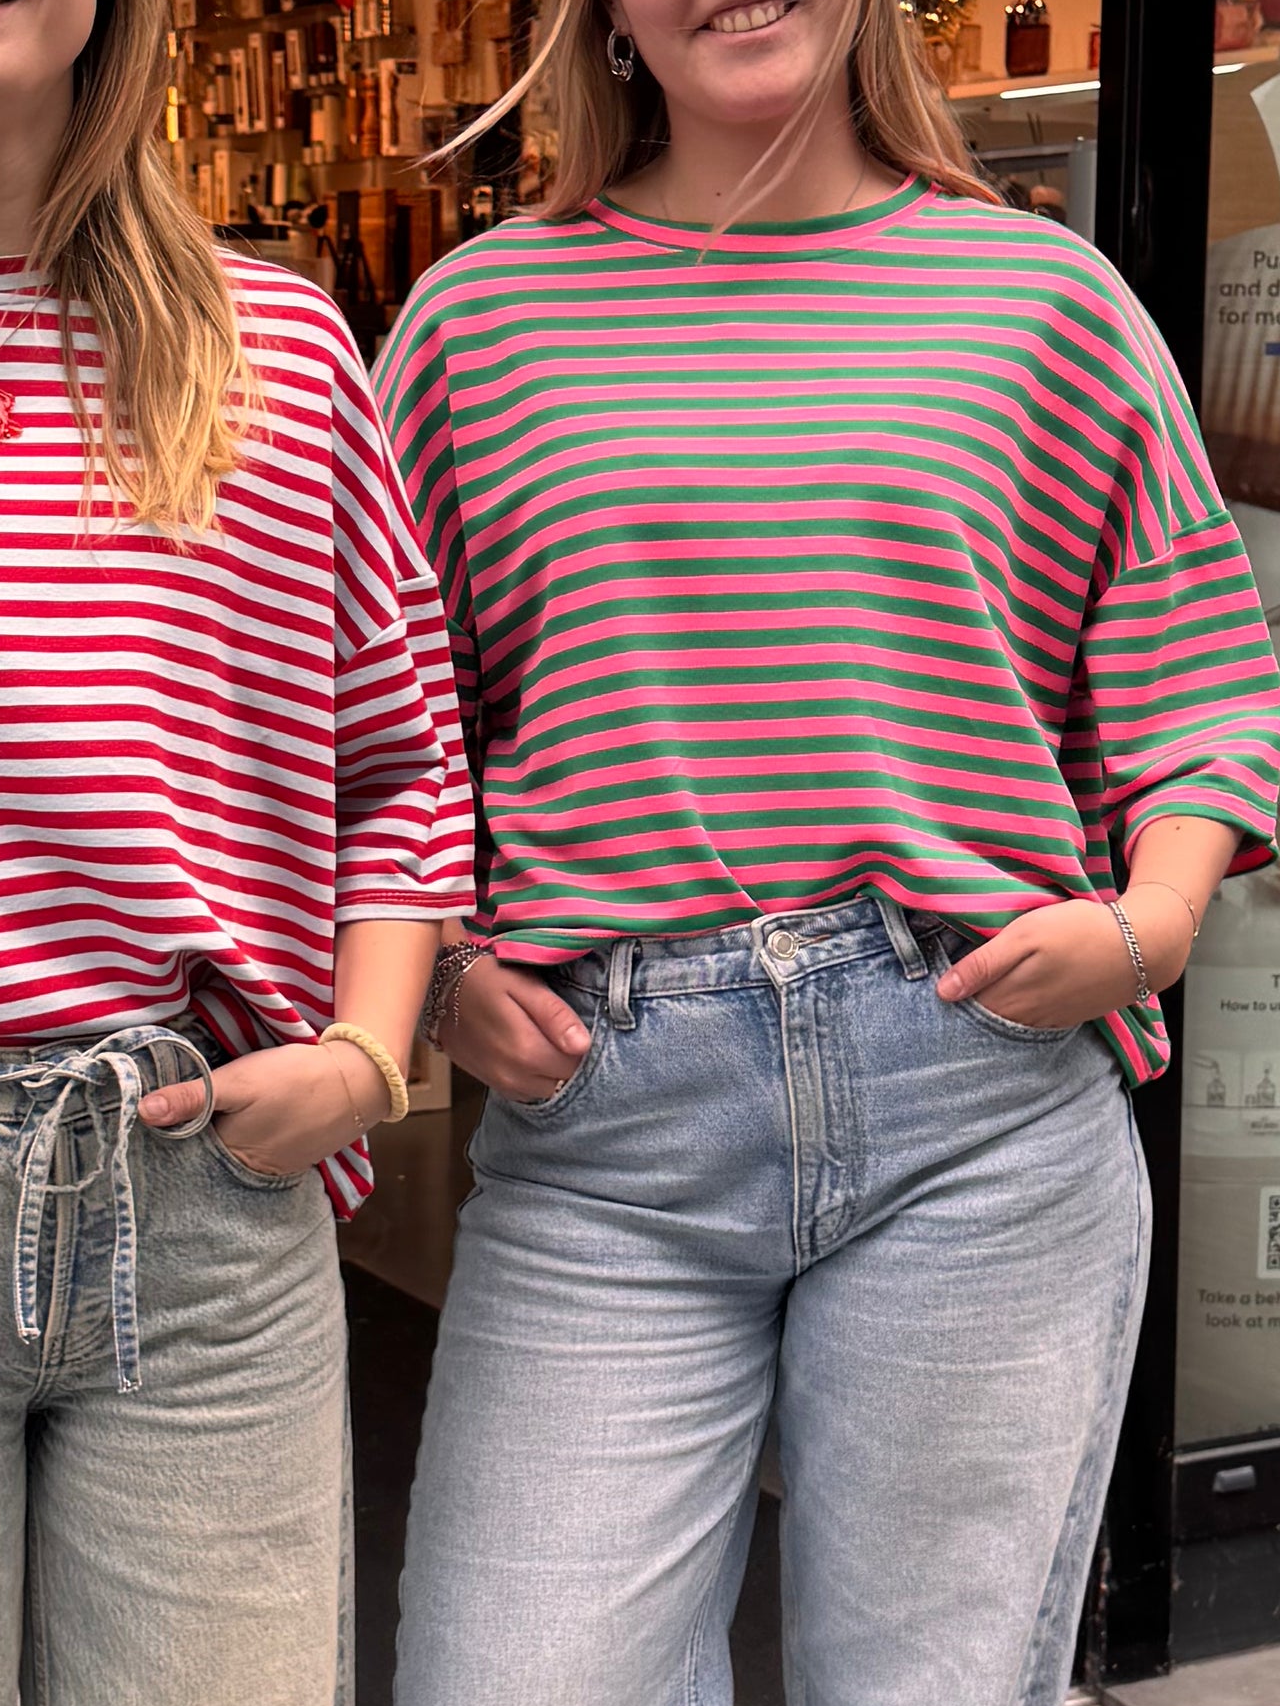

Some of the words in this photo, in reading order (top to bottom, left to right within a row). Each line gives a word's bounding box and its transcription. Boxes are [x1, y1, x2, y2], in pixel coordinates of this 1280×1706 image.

[1220, 280, 1261, 297] and
[1219, 306, 1249, 324] for
[1220, 999, 1249, 1012] How
[1253, 1000, 1267, 1012] to
[1197, 1288, 1235, 1304] Take
[1239, 1293, 1251, 1305] a
[1205, 1313, 1241, 1328] look
[1245, 1315, 1264, 1328] at
